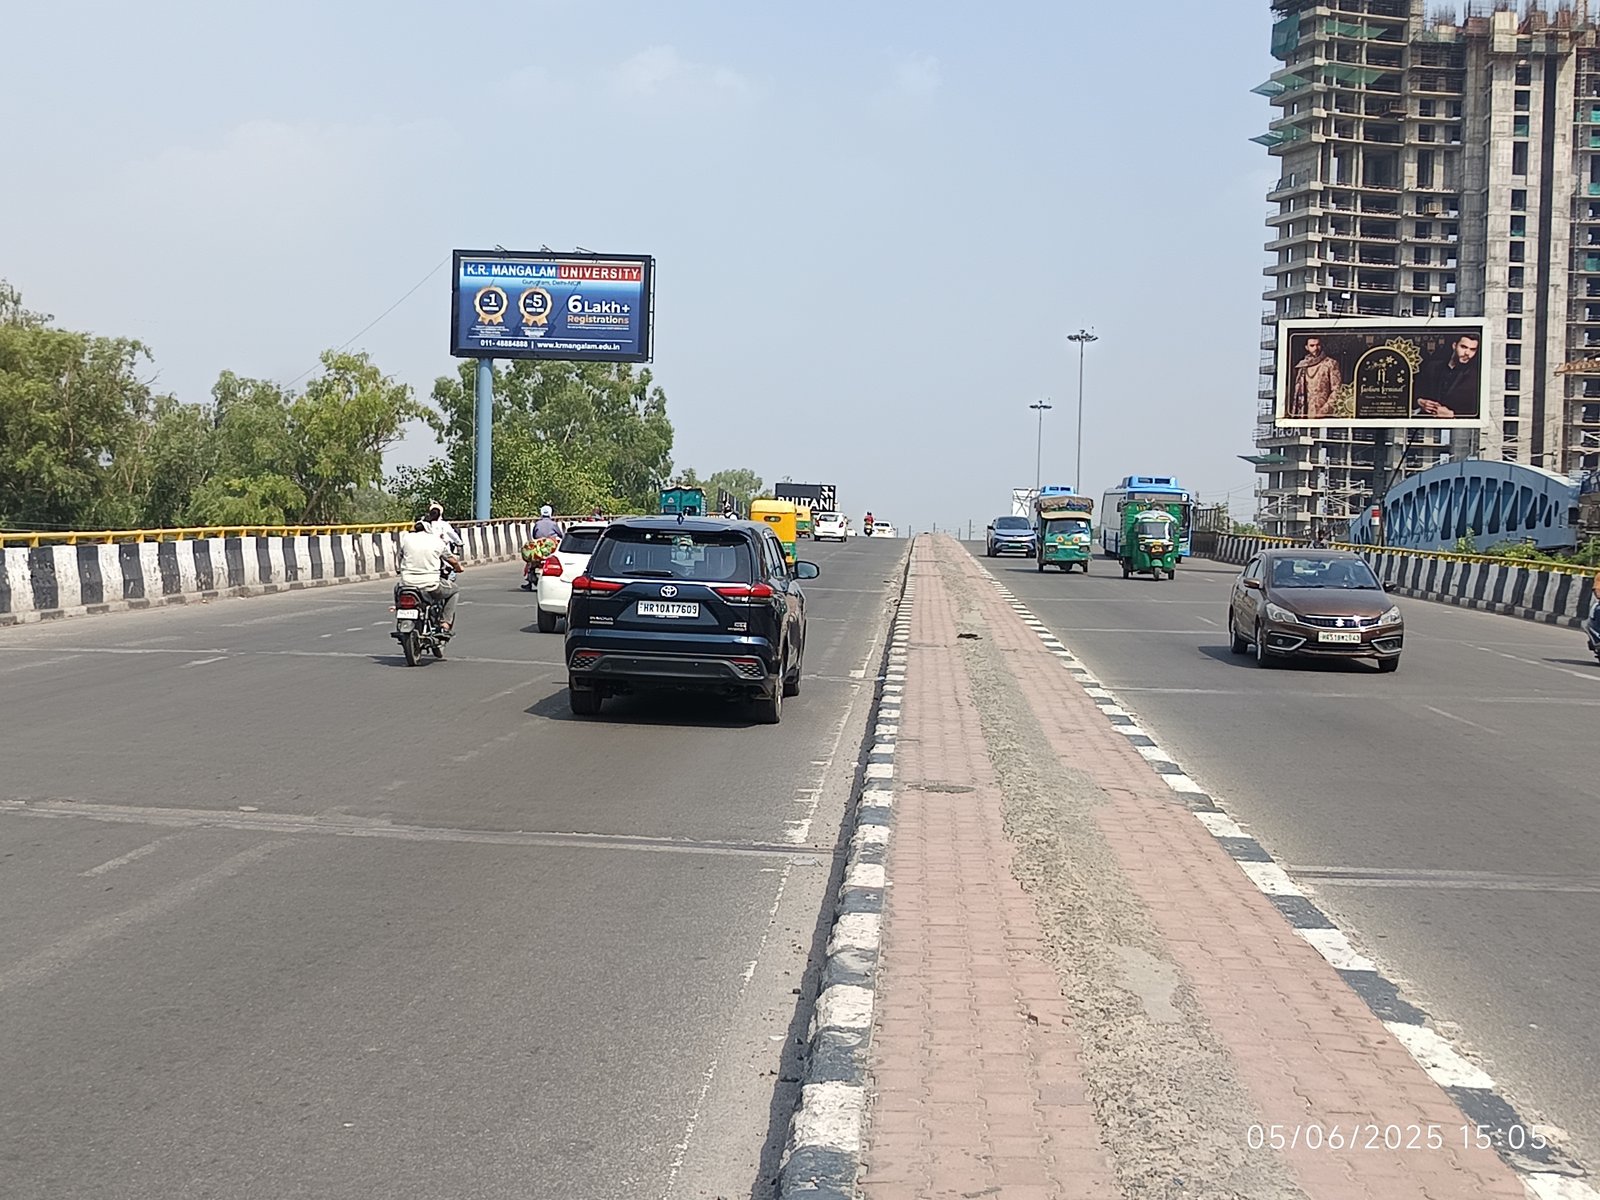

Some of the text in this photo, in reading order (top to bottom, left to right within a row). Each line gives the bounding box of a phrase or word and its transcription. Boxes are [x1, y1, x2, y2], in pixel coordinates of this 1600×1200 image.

[467, 264, 640, 280] K.R. MANGALAM UNIVERSITY
[568, 295, 631, 314] 6 Lakh+
[567, 314, 630, 325] Registrations
[537, 341, 621, 351] www.krmangalam.edu.in
[643, 603, 698, 615] HR10AT7609
